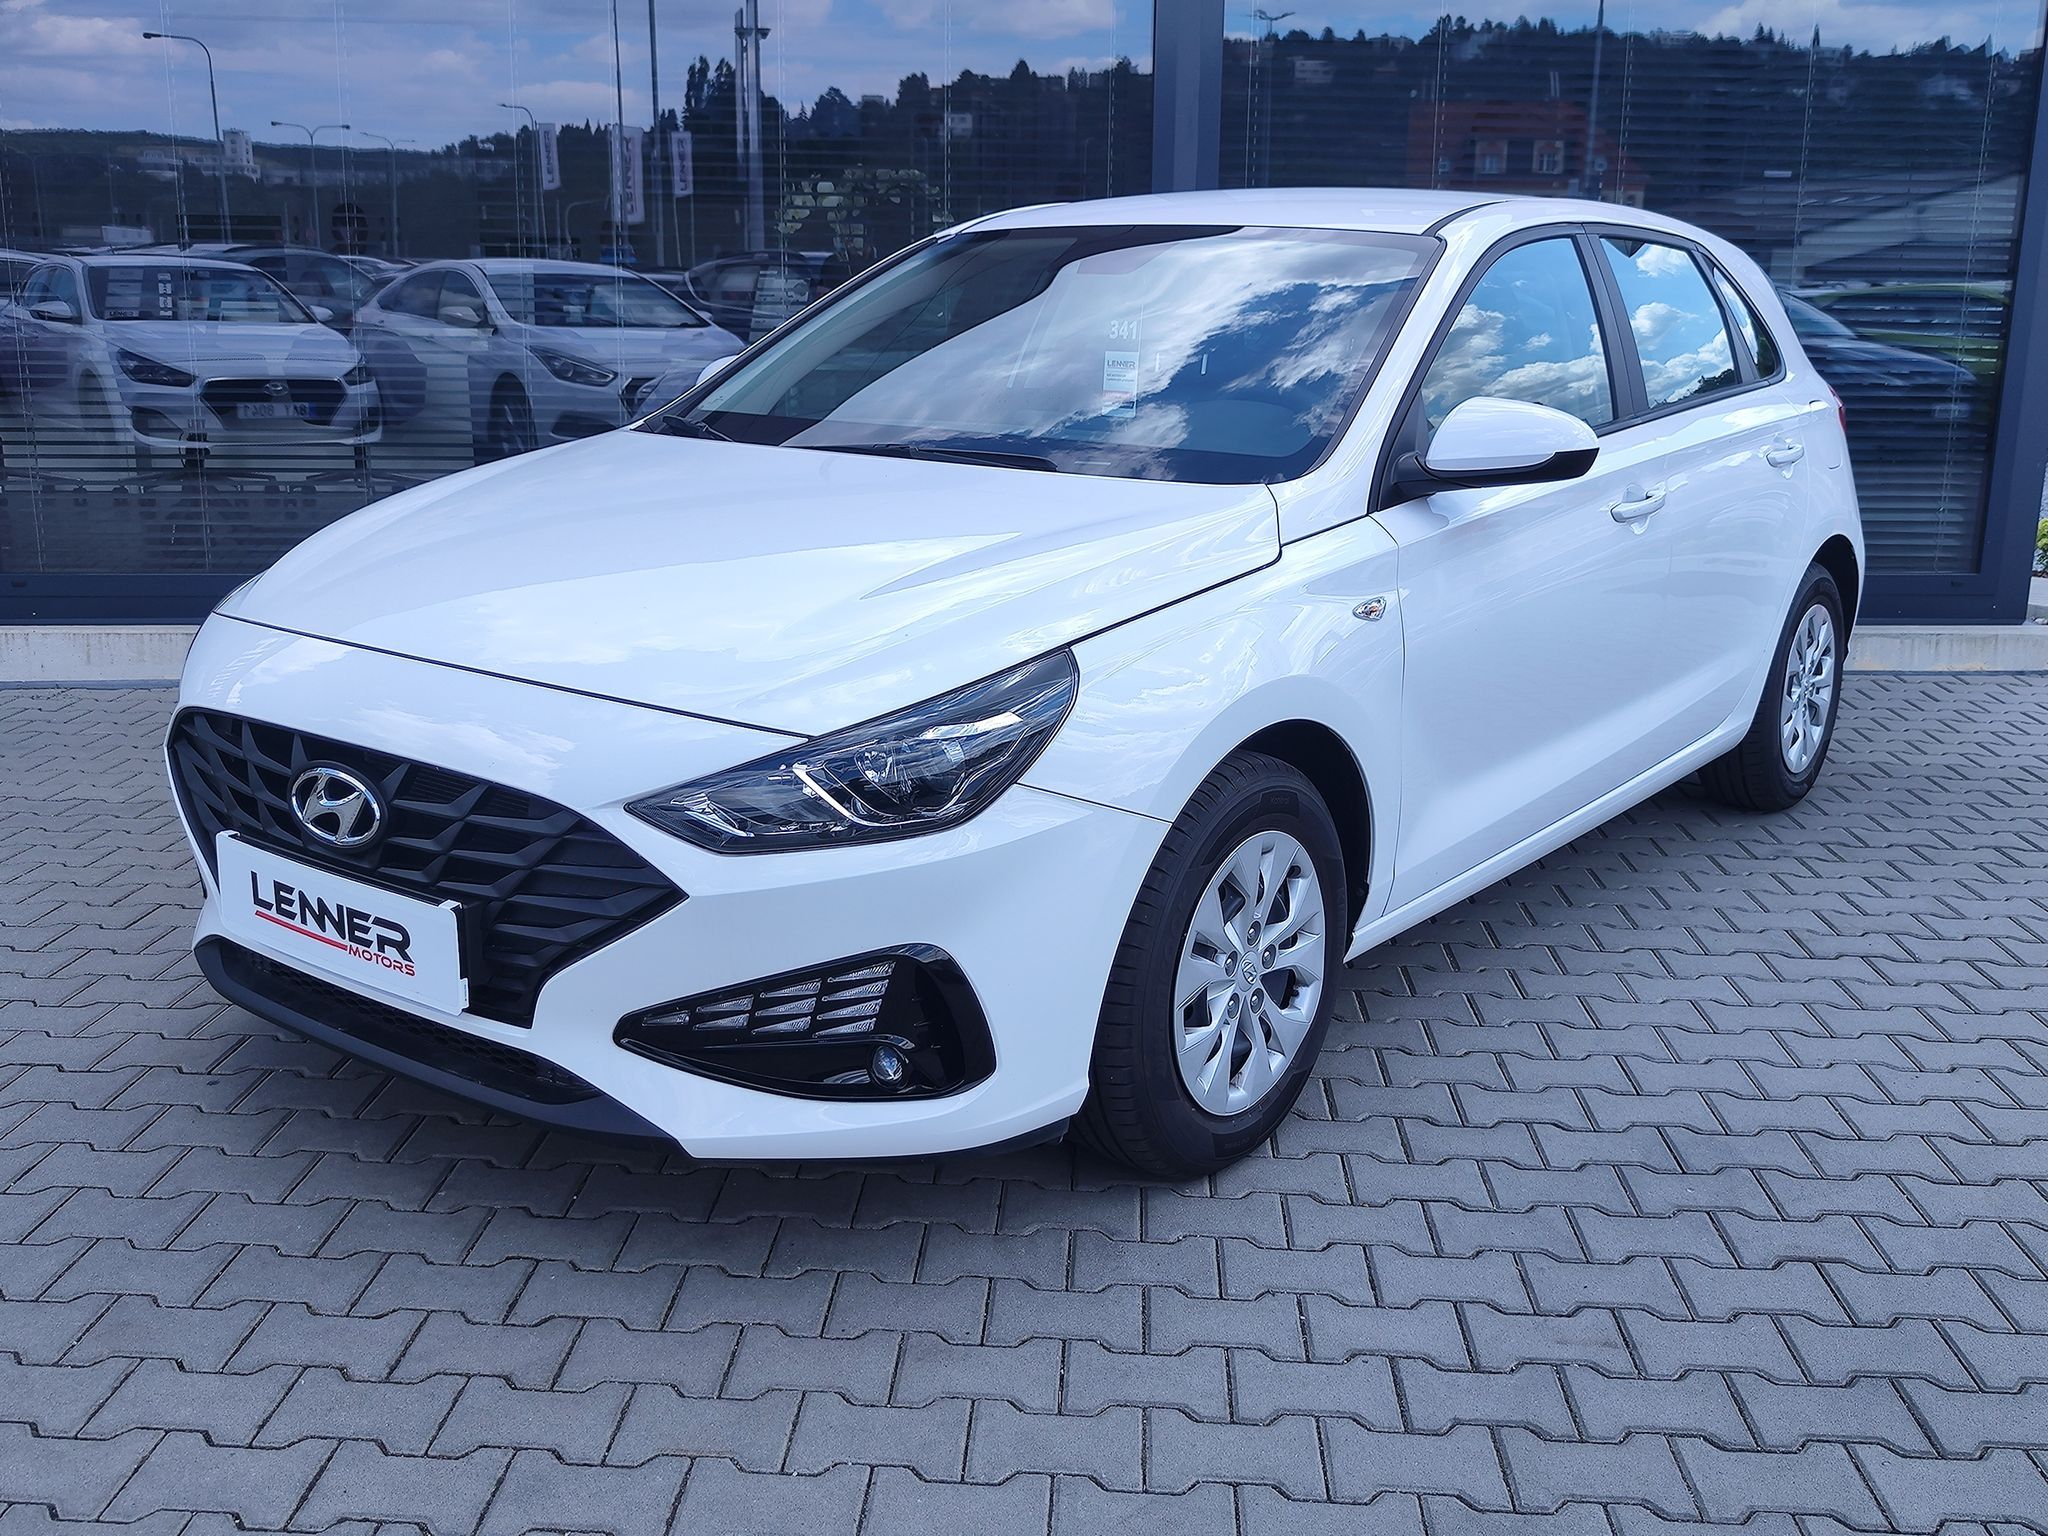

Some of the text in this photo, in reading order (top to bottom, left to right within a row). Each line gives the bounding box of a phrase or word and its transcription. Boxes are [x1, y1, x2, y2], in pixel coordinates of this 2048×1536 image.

[1108, 319, 1137, 340] 341
[1107, 359, 1136, 369] LENNER
[251, 871, 415, 965] LENNER
[348, 945, 416, 977] MOTORS
